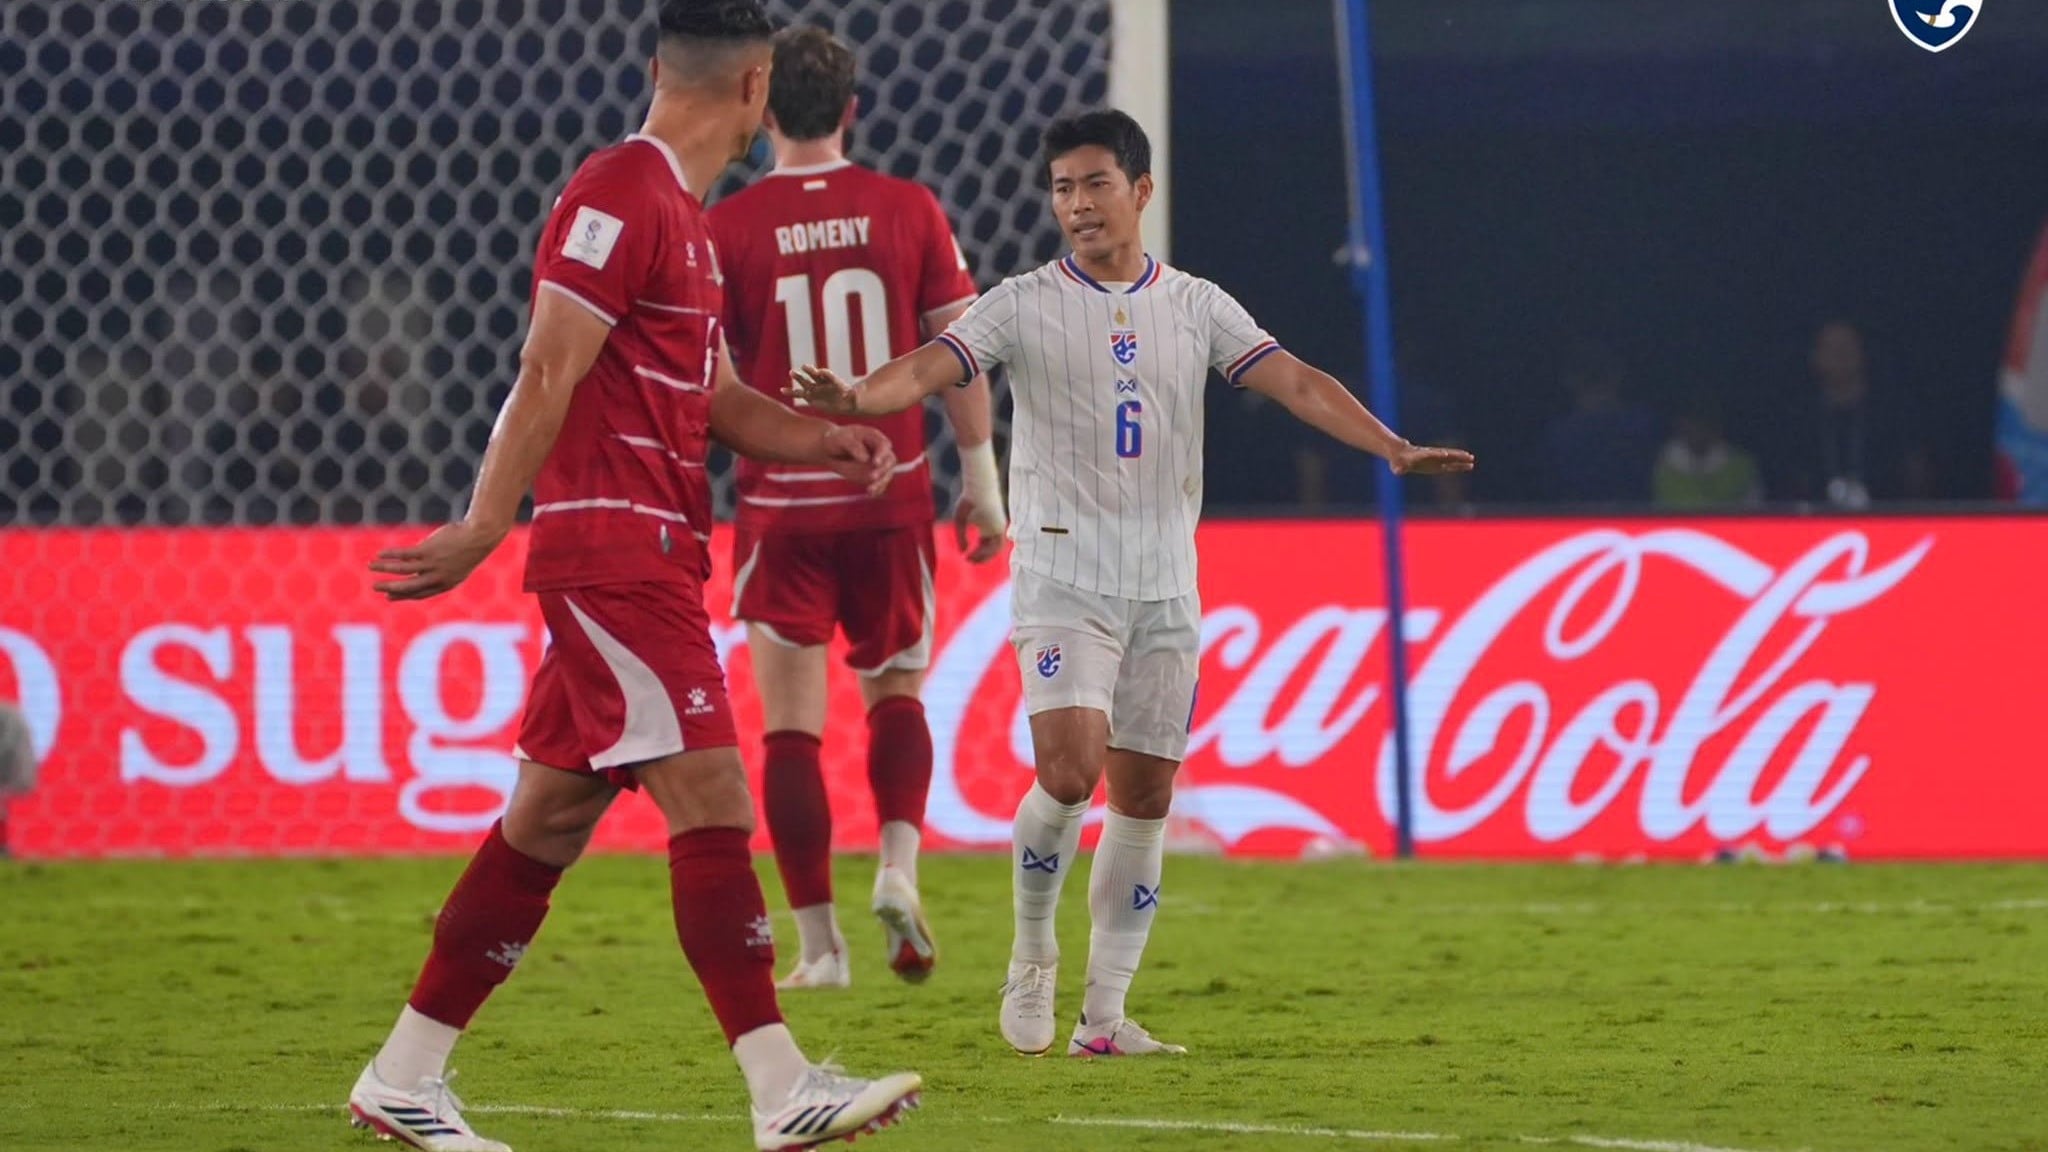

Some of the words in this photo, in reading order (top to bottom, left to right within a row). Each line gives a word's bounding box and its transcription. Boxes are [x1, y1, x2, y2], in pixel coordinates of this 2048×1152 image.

[775, 216, 870, 255] ROMENY
[775, 268, 892, 406] 10
[1116, 401, 1142, 459] 6
[119, 621, 748, 831] sug
[918, 528, 1937, 845] Cca-Cola
